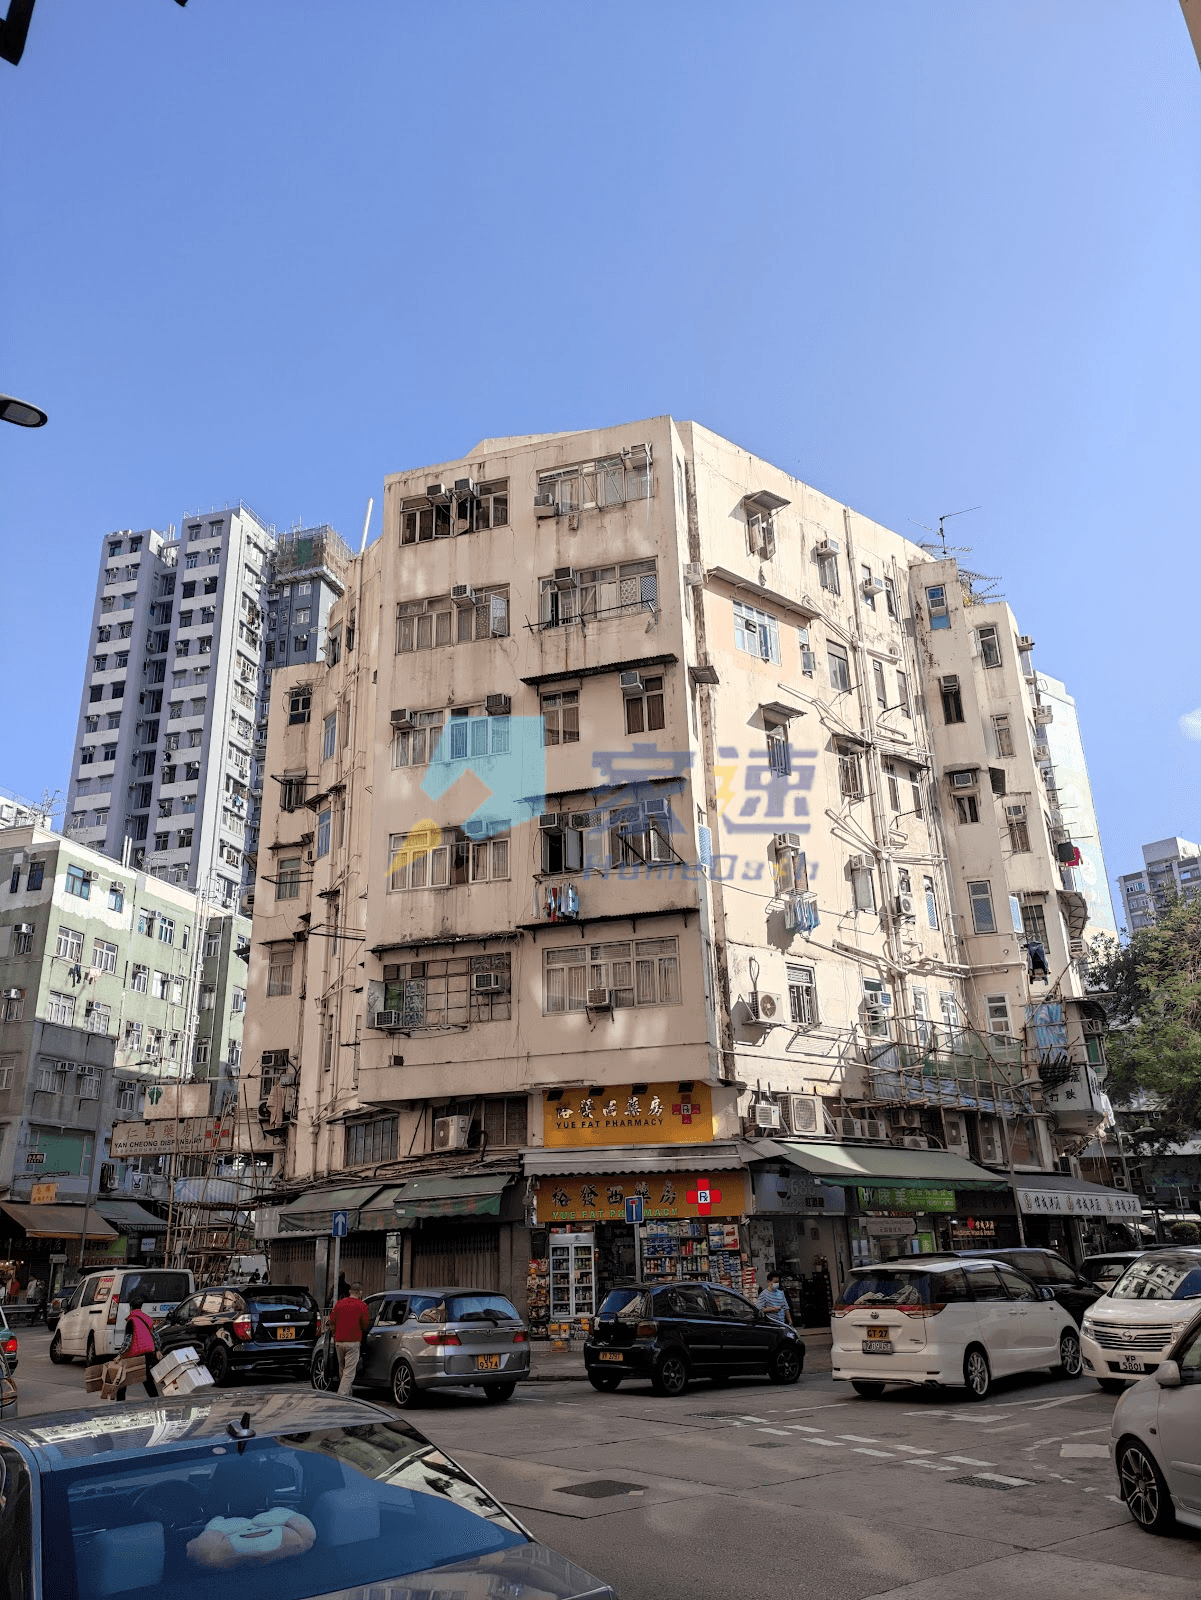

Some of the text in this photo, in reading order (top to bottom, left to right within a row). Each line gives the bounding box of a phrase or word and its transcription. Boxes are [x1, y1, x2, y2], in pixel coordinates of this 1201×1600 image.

[556, 1118, 663, 1129] YUE FAT PHARMACY
[126, 1122, 192, 1140] 仁昌藥房
[114, 1137, 203, 1149] YAN CHEONG DISPNSARY
[552, 1179, 677, 1208] 裕發西藥房
[552, 1207, 678, 1220] YUE FAT PHMACY
[867, 1329, 888, 1338] GT 27
[1124, 1354, 1136, 1363] WP
[1122, 1361, 1142, 1371] 5801
